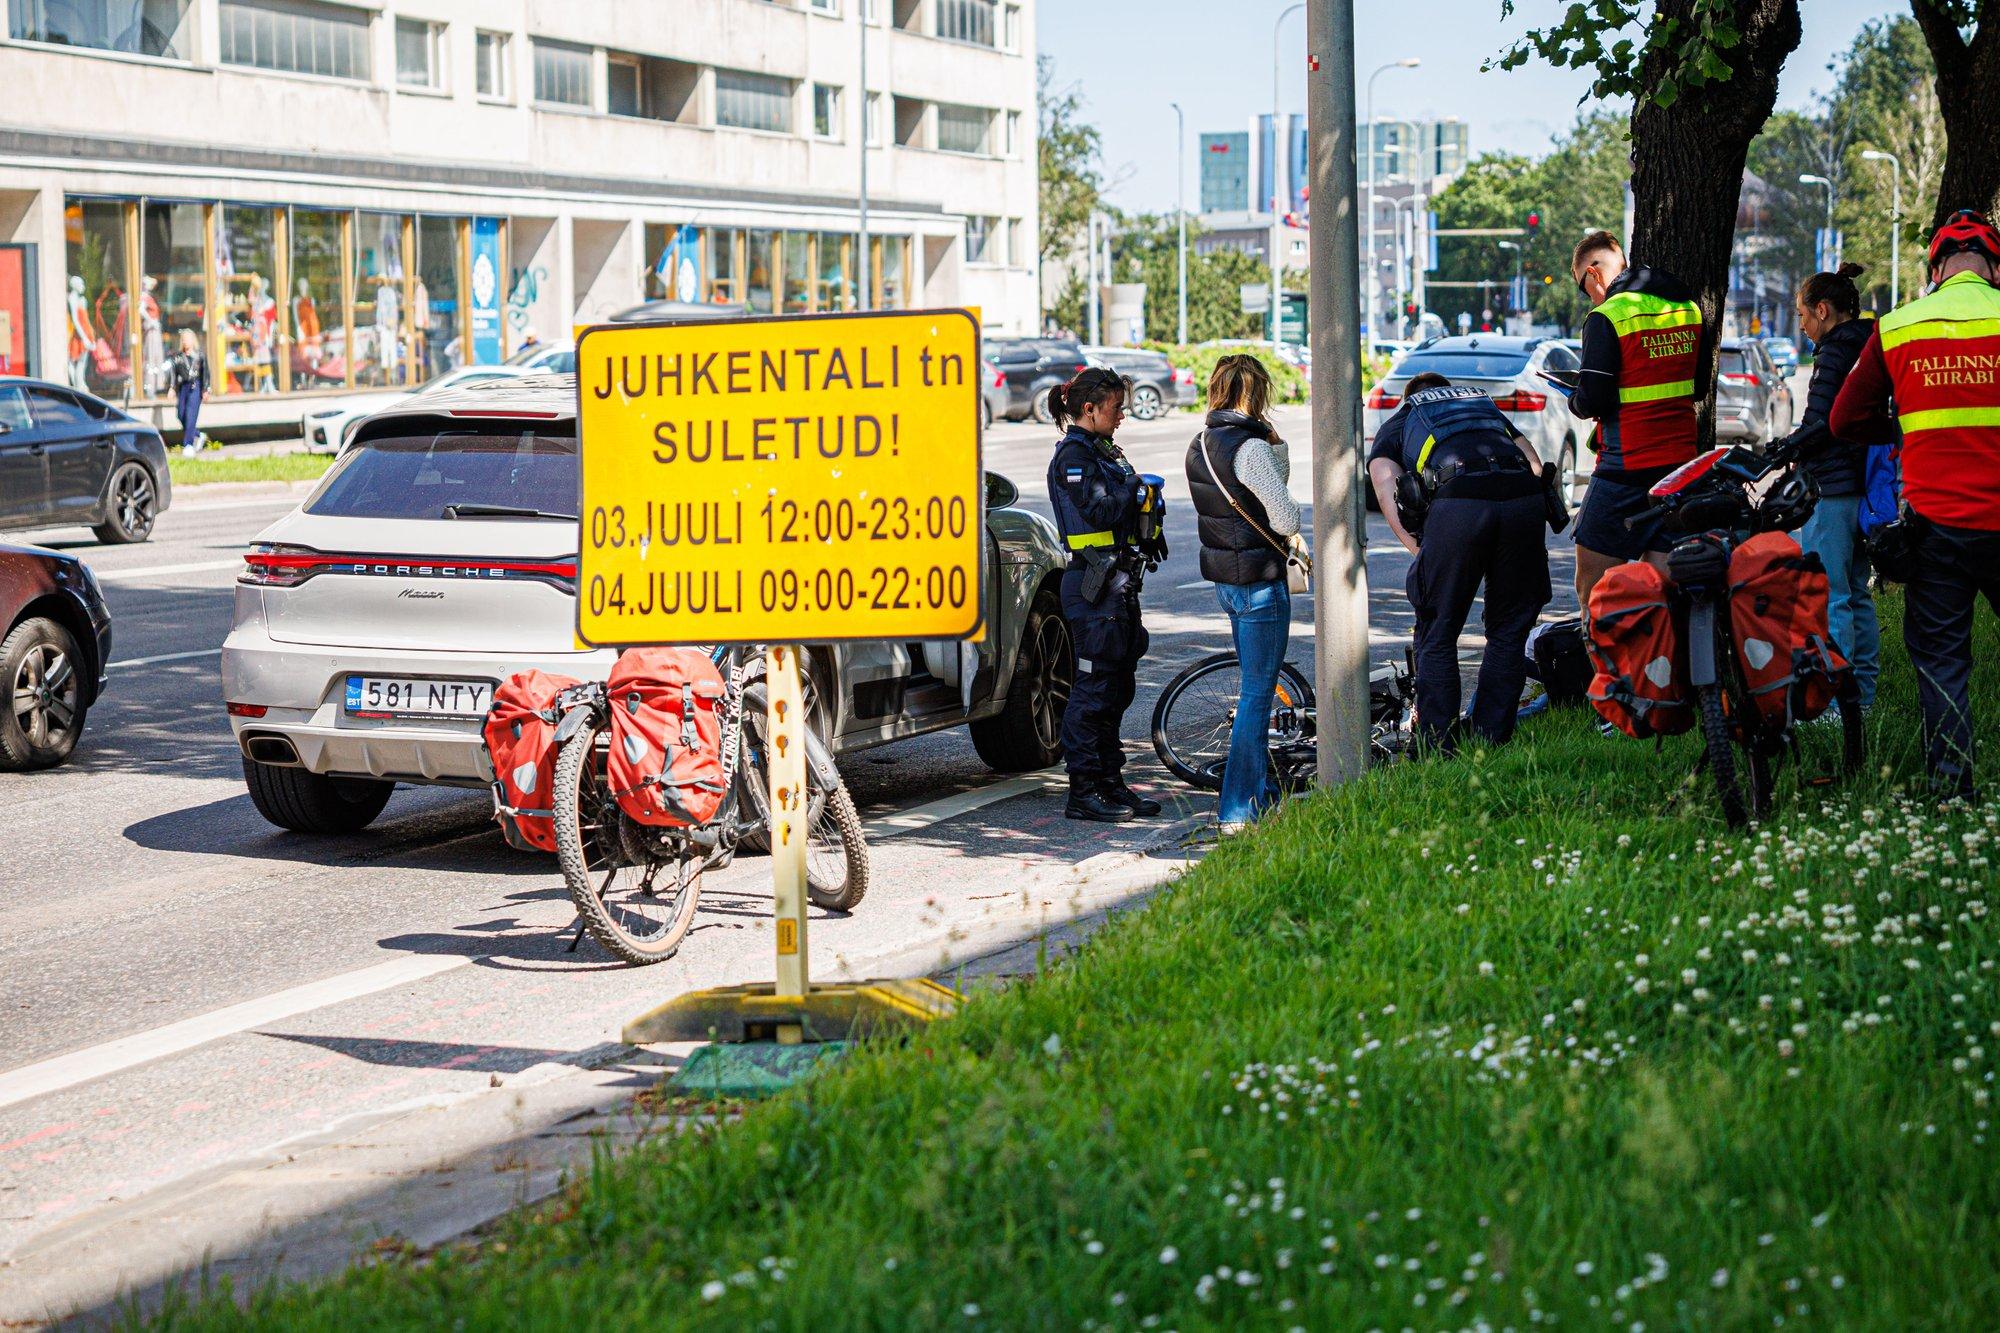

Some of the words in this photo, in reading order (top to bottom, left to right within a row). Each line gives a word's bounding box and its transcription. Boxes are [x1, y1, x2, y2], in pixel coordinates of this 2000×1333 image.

[1641, 330, 1696, 347] TALLINNA
[1649, 342, 1693, 358] KIIRABI
[594, 345, 900, 400] JUHKENTALI
[919, 345, 963, 387] tn
[1923, 370, 1994, 386] KIIRABI
[652, 413, 900, 464] SULETUD!
[591, 501, 742, 549] 03.JUULI
[760, 495, 966, 543] 12:00-23:00
[353, 564, 504, 577] PORSCHE
[590, 570, 742, 616] 04.JUULI
[760, 565, 966, 612] 09:00-22:00
[347, 698, 361, 706] EST
[368, 682, 413, 708] 581
[428, 684, 485, 711] NTY
